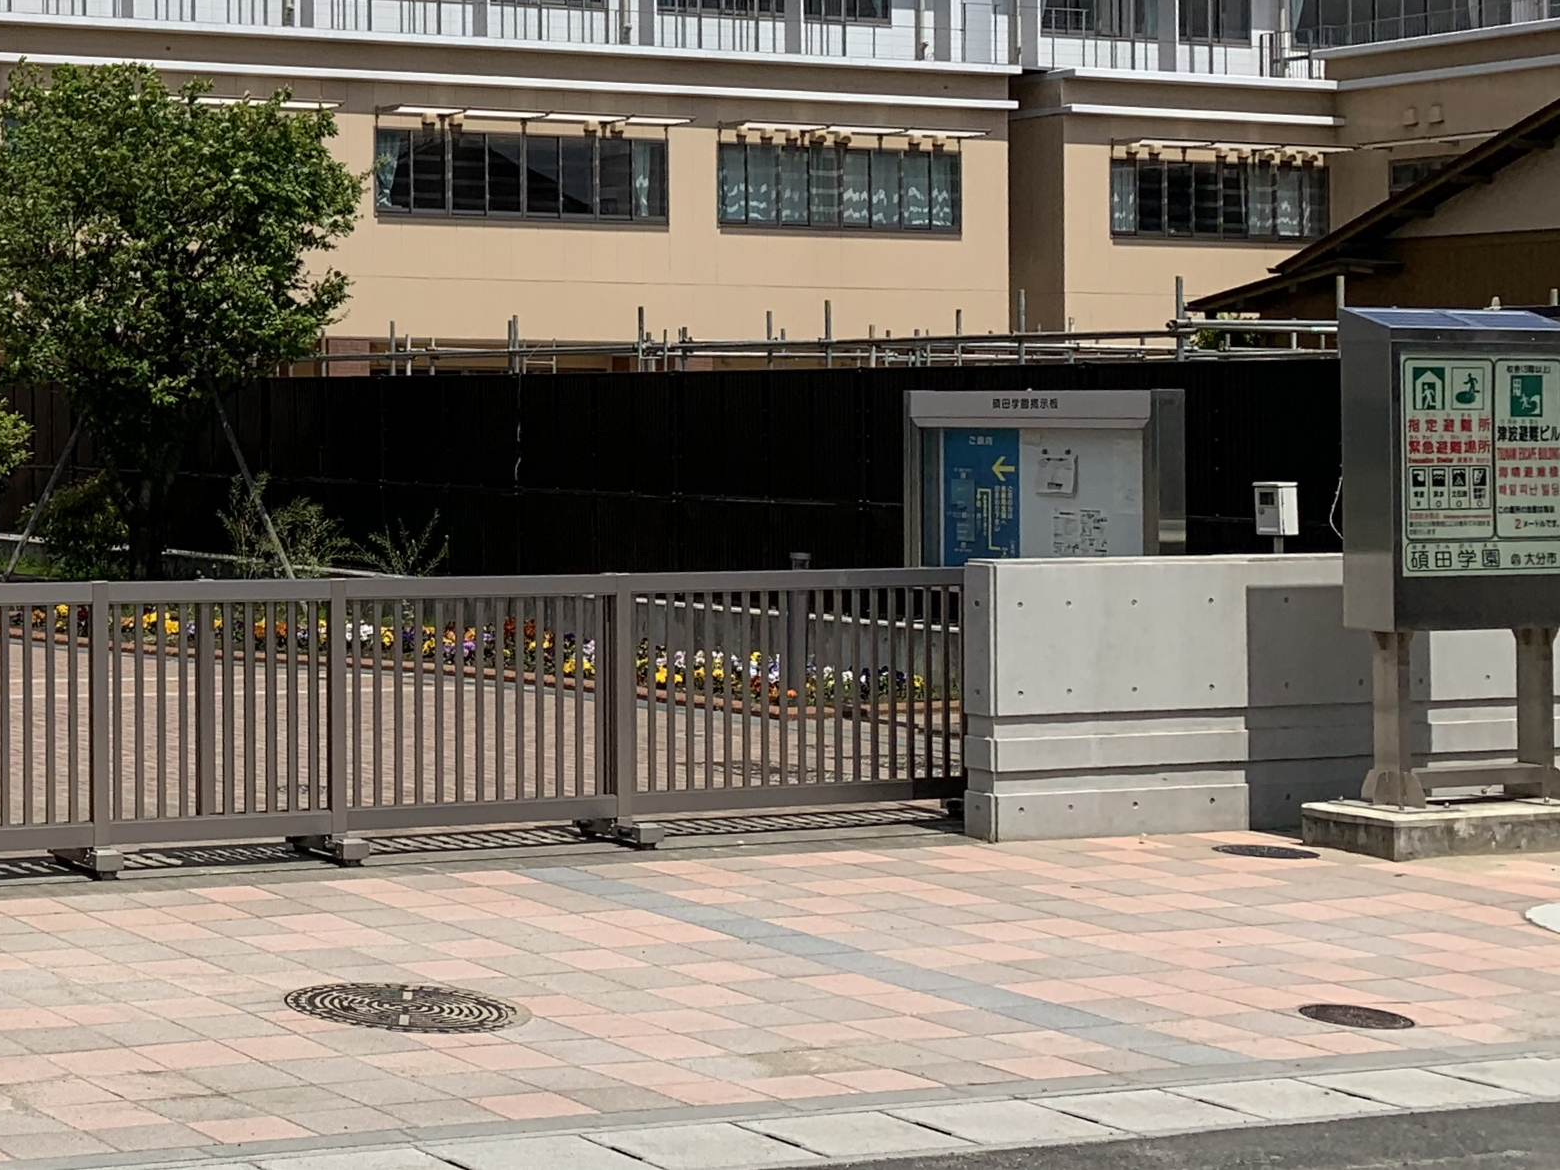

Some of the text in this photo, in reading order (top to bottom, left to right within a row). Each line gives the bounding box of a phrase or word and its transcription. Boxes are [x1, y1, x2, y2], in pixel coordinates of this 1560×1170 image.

[1408, 418, 1490, 432] 指定避難所
[1497, 425, 1560, 442] 津波避難ビル
[1408, 440, 1491, 454] 緊急避難場所
[1411, 549, 1500, 569] 碩田学園
[1524, 552, 1558, 566] 大分市
